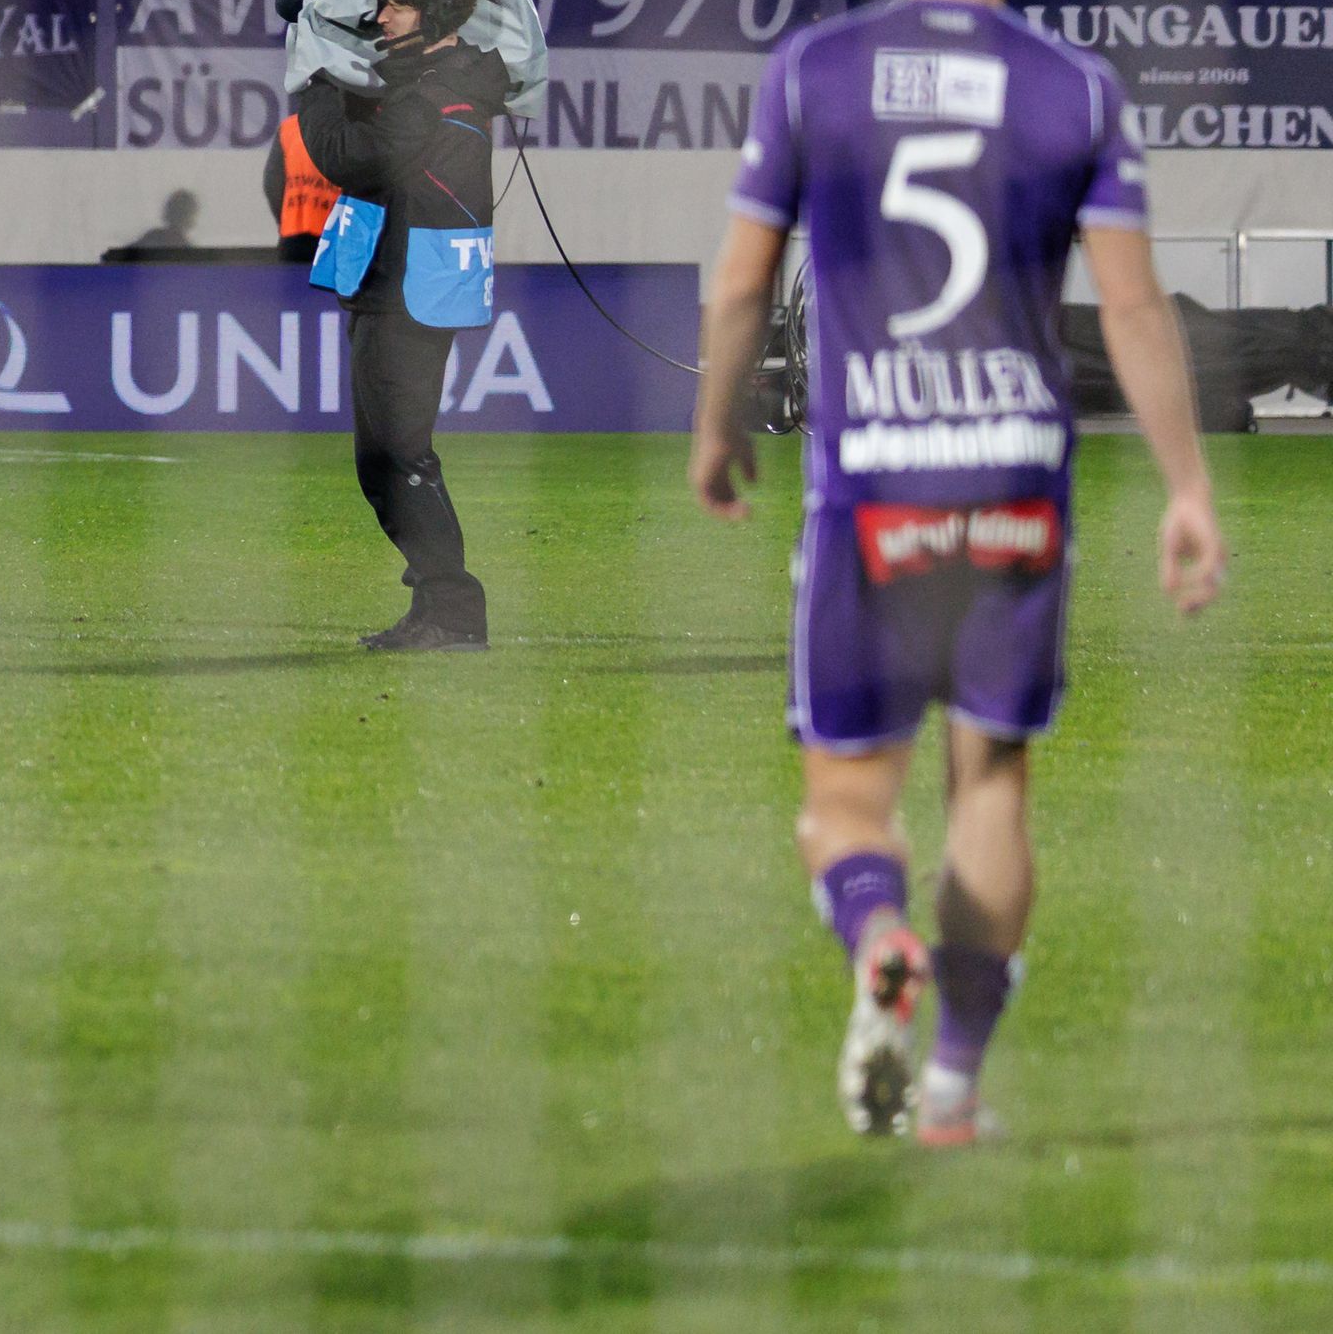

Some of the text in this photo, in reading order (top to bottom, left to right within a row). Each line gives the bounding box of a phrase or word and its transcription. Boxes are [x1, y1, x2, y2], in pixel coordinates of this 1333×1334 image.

[1024, 4, 1333, 49] LUNGAUE
[1139, 67, 1193, 84] since
[880, 129, 988, 339] 5
[111, 310, 554, 415] UNIA
[844, 339, 1058, 420] MÜLLER
